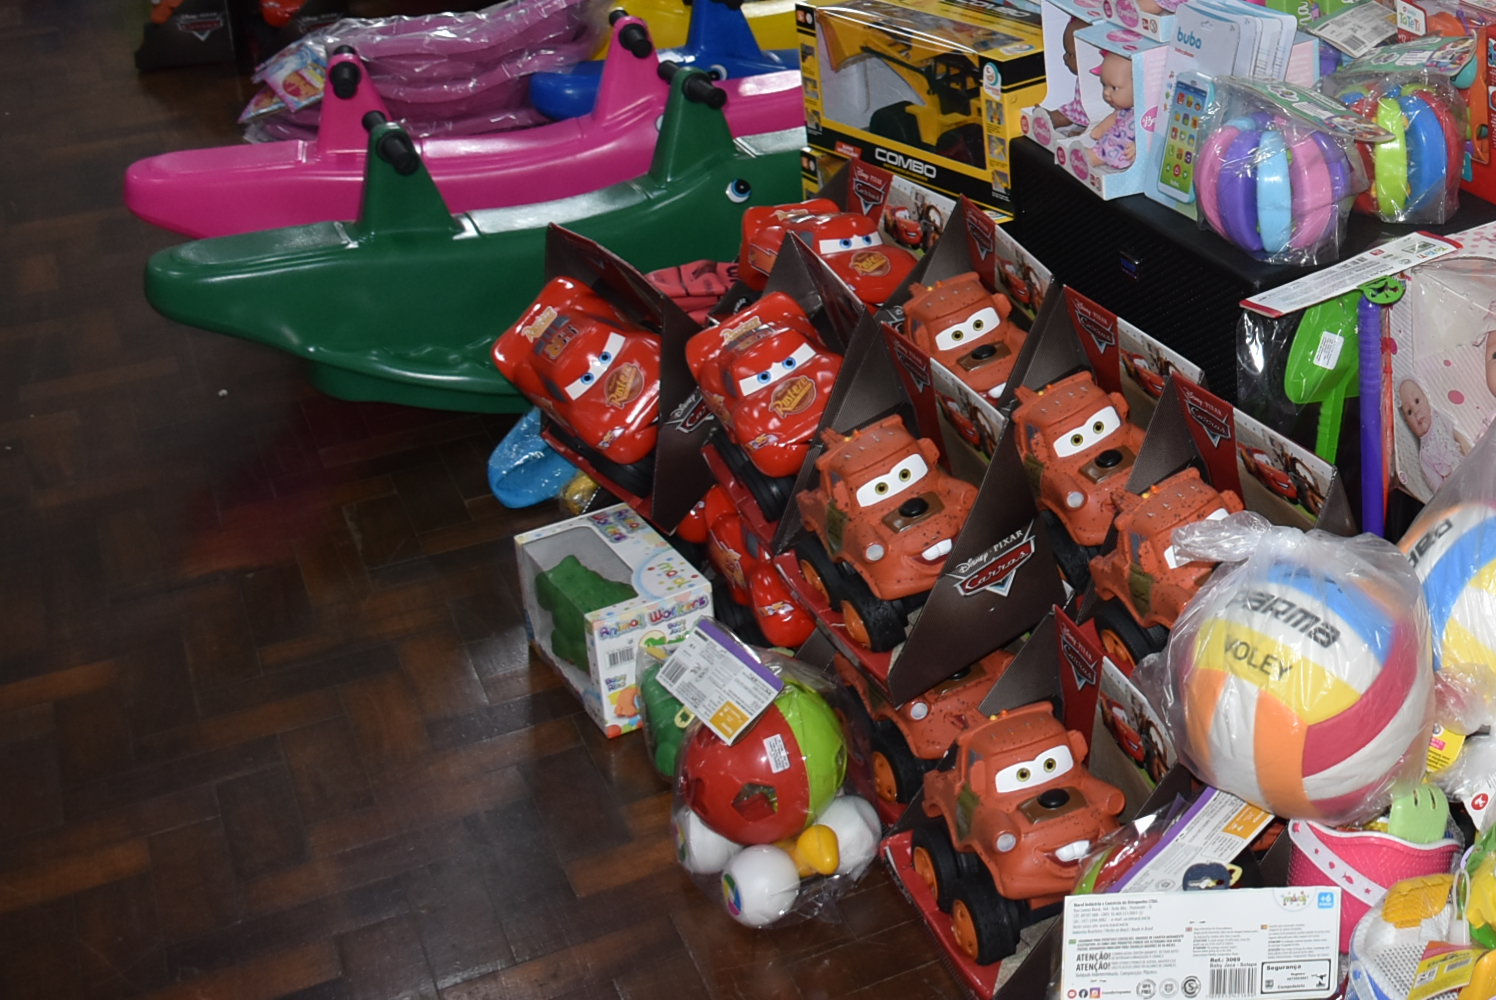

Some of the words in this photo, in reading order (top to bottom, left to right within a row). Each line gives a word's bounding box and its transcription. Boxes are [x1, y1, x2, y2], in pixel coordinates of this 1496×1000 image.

[1176, 27, 1203, 50] buba
[874, 147, 937, 179] COMBO
[955, 551, 990, 574] Disney
[992, 529, 1025, 553] PIXAR
[964, 550, 1030, 591] Carros
[599, 613, 646, 640] Animal
[648, 595, 711, 625] Workers
[1224, 636, 1293, 682] VOLEY
[1075, 951, 1112, 964] ATENÇÃO!
[1075, 961, 1112, 973] ATENÇÃO!
